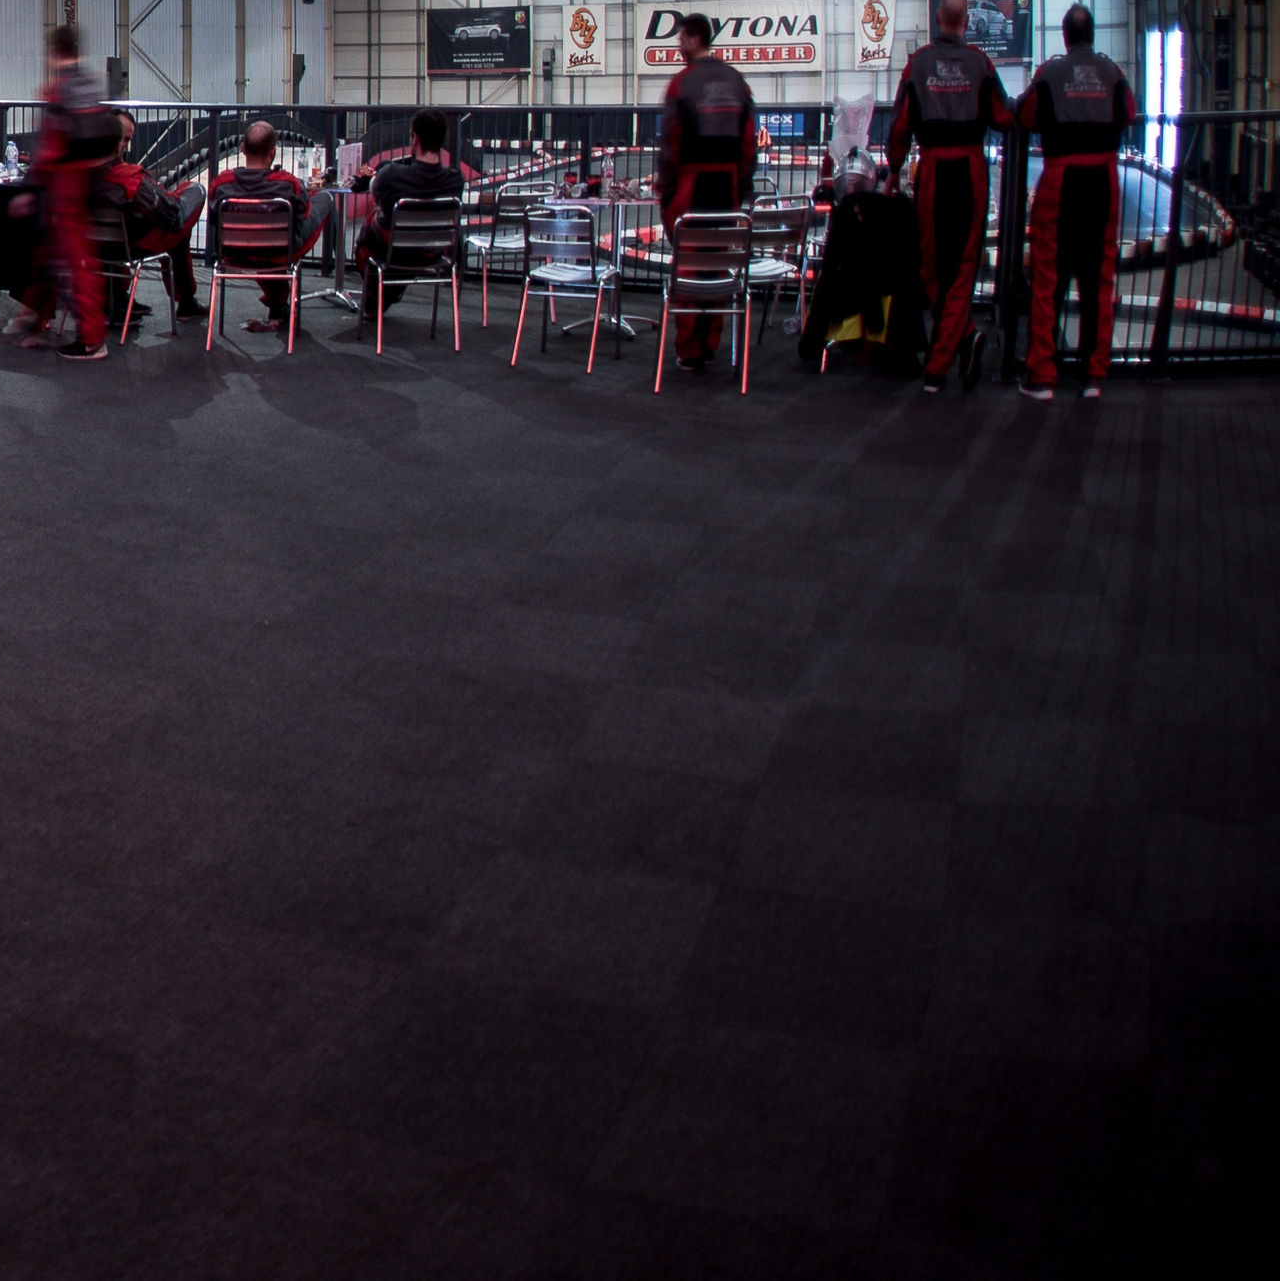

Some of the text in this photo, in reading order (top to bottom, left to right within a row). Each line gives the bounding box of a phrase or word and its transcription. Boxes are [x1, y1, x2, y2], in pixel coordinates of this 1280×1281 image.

[570, 13, 598, 44] BIZ
[644, 9, 818, 46] DYTONA
[861, 4, 889, 36] BIZ
[569, 50, 594, 65] Karts
[655, 47, 806, 61] MACHESTER
[861, 43, 886, 60] Karts
[759, 115, 793, 124] BOX
